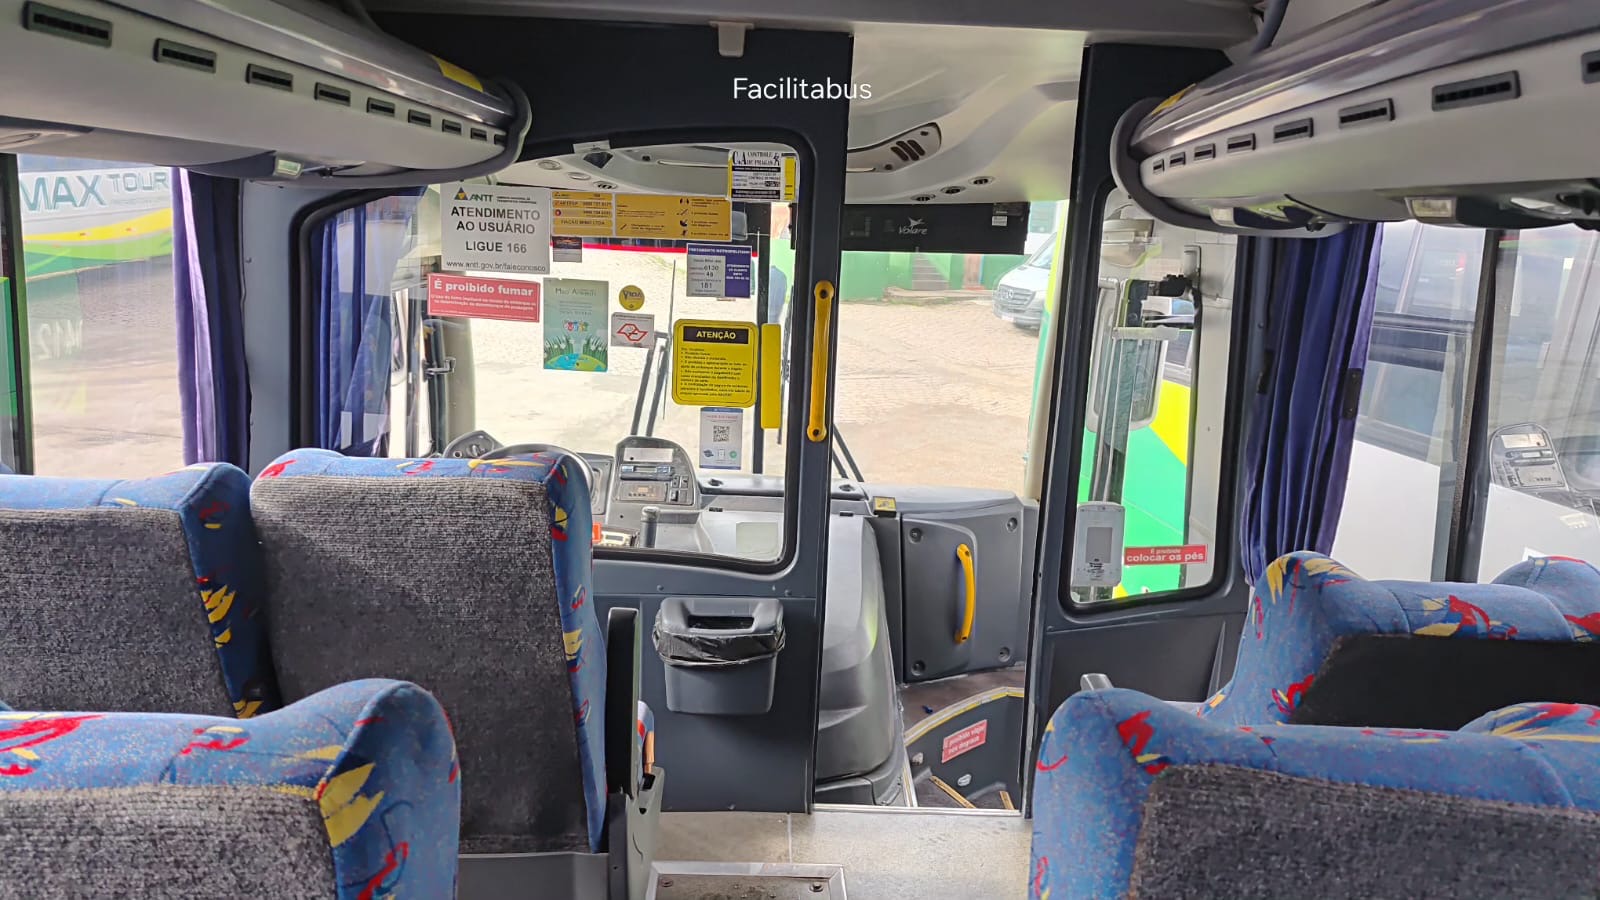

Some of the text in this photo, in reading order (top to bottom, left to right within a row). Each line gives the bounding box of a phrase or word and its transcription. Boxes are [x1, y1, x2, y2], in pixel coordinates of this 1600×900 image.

[107, 172, 170, 193] TOUR
[469, 193, 494, 202] ANTT
[451, 206, 540, 220] ATENDIMENTO
[456, 220, 536, 234] AO USUÁRIO
[465, 241, 527, 254] LIGUE 166
[434, 278, 534, 296] É proibido fumar
[696, 331, 736, 340] ATENÇÃO
[1126, 553, 1166, 562] colocar
[1184, 551, 1204, 561] pés
